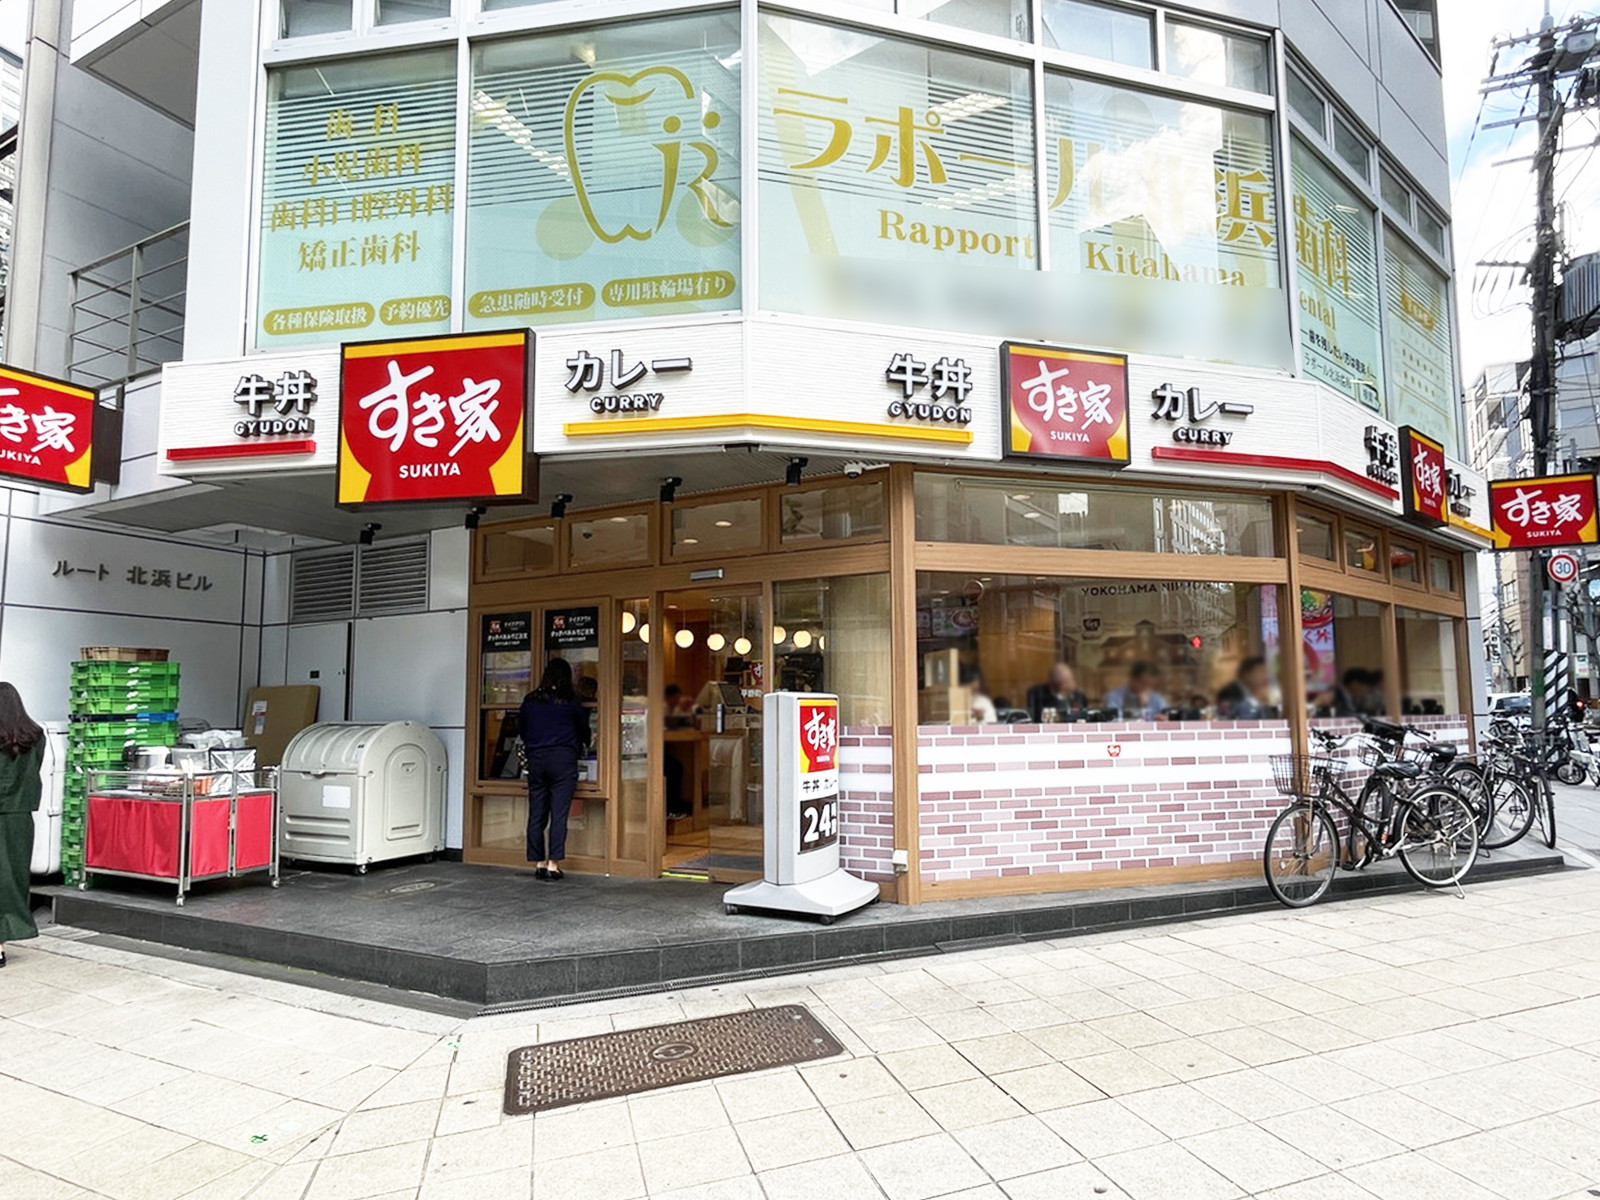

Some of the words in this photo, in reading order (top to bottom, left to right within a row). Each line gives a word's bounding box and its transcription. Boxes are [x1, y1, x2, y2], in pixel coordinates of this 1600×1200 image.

[302, 142, 422, 186] 小児歯科
[298, 230, 421, 272] 矯正歯科
[878, 209, 1036, 260] Rapport
[609, 276, 727, 302] 専用駐輪場有り
[386, 299, 449, 321] 予約優先
[565, 349, 693, 393] カレー
[886, 353, 974, 402] 牛丼
[234, 370, 317, 415] 牛丼
[359, 361, 501, 457] すき家
[590, 393, 664, 414] CURRY
[1020, 360, 1114, 430] すき家
[1152, 383, 1254, 423] カレー
[233, 419, 315, 438] GYUDON
[887, 402, 972, 423] GYUDON
[1050, 431, 1091, 443] SUKIYA
[1174, 427, 1233, 446] CURRY
[399, 461, 461, 479] SUKIYA
[1413, 443, 1442, 498] すき家
[1501, 488, 1583, 528] すき家
[1526, 529, 1562, 539] SUKIYA
[52, 560, 110, 581] ルート
[126, 566, 213, 592] 北浜ビル
[1555, 561, 1572, 574] 30
[1081, 583, 1158, 597] YOKOHAMA
[804, 708, 836, 752] すき家
